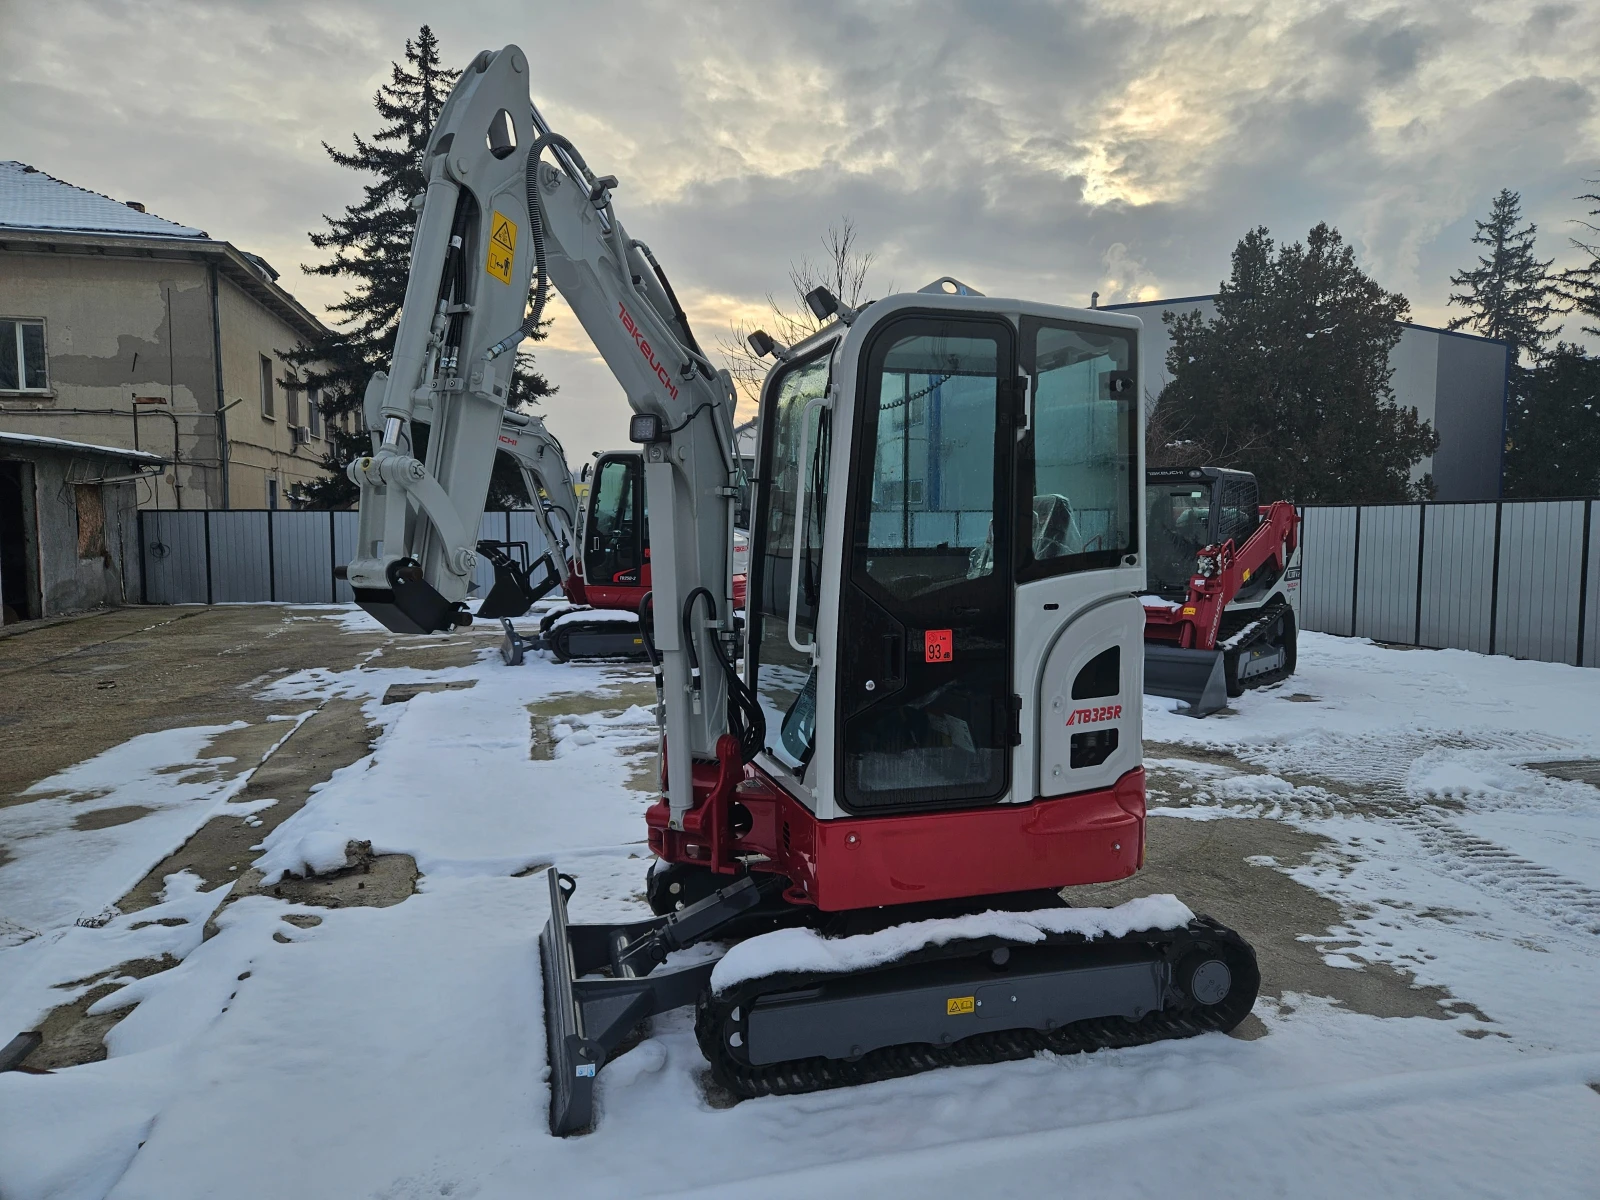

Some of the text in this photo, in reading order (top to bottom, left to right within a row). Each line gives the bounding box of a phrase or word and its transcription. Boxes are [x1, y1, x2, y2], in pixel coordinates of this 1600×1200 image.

[618, 301, 679, 400] TAKEUCHI
[928, 644, 942, 660] 93
[1076, 704, 1123, 724] TB325R
